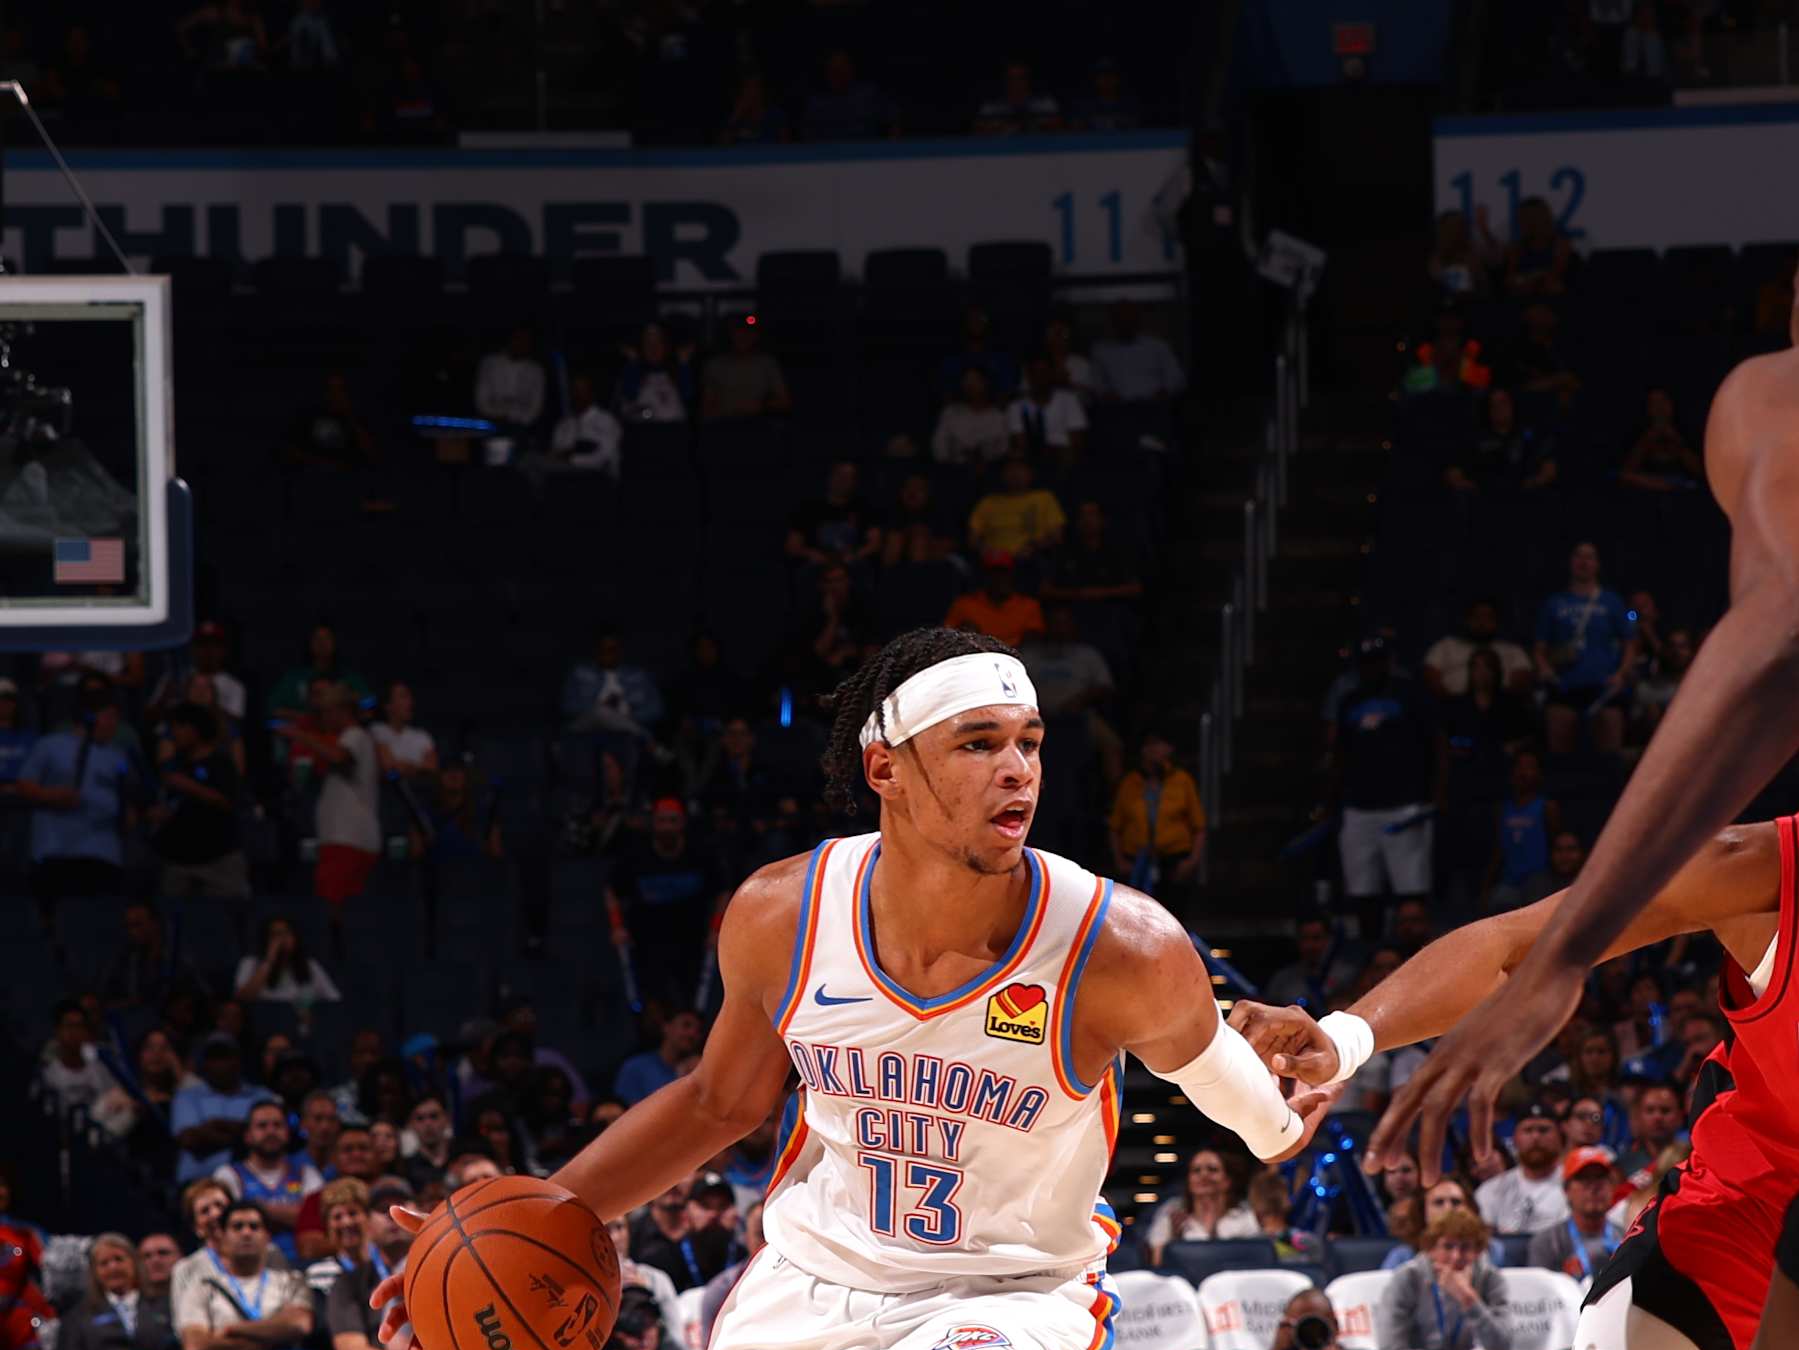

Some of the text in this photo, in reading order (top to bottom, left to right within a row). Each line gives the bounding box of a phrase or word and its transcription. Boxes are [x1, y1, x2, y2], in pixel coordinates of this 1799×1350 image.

[1452, 167, 1586, 240] 112
[1, 204, 742, 282] THUNDER
[789, 1039, 1050, 1134] OKLAHOMA
[855, 1106, 967, 1163] CITY
[857, 1150, 965, 1247] 13
